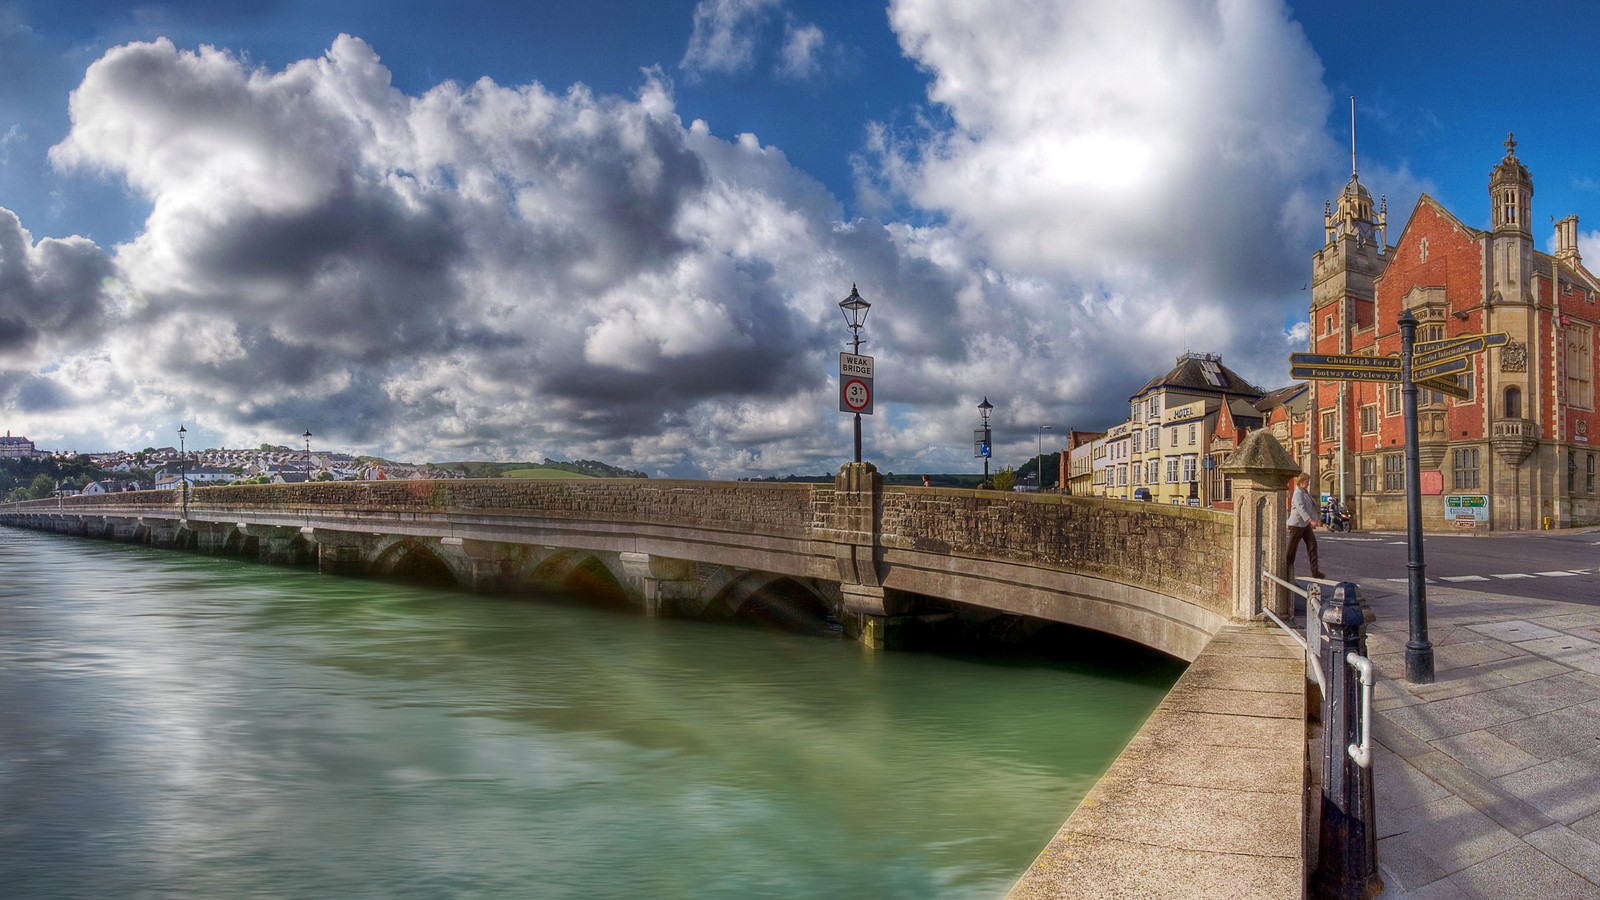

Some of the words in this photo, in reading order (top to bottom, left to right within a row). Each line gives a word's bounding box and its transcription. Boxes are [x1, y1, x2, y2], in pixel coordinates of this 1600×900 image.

[1420, 352, 1437, 363] Tourist
[1438, 345, 1470, 358] Information
[846, 356, 867, 366] WEAK
[1326, 356, 1370, 366] Chudleigh
[1373, 357, 1390, 366] Fort
[842, 364, 871, 375] BRIDGE
[1312, 369, 1345, 378] Footway
[1419, 368, 1437, 377] Toilets
[1174, 407, 1193, 418] HOTEL
